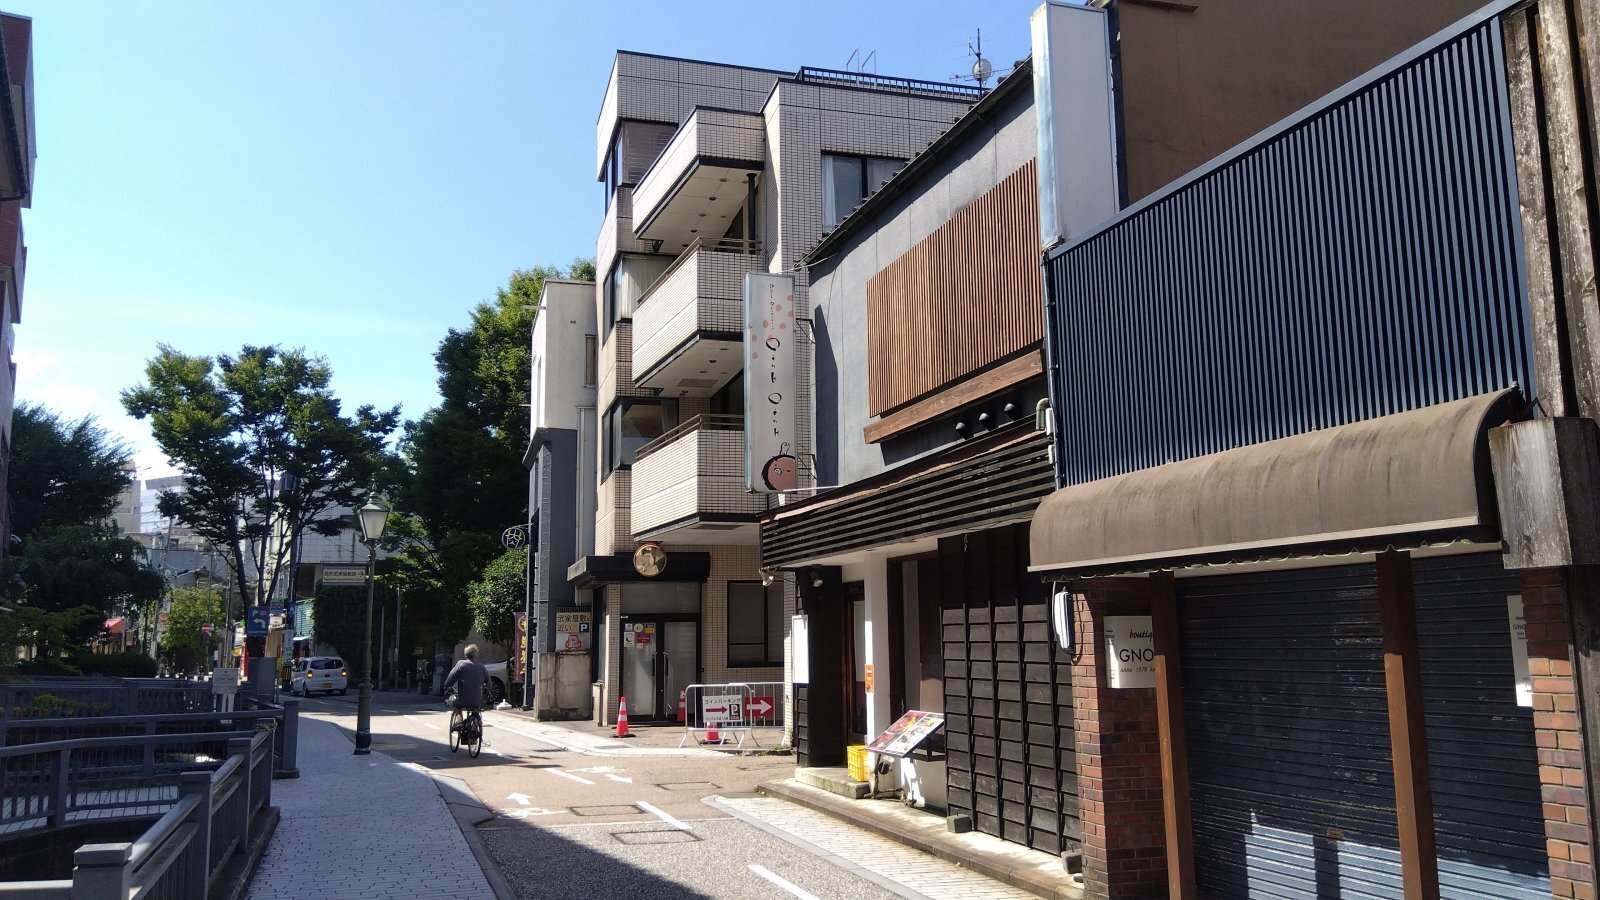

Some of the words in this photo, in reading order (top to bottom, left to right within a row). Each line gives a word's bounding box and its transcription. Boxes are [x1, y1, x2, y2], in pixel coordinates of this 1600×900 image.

[557, 624, 572, 632] 近い
[580, 623, 588, 632] P
[1119, 648, 1154, 662] GNO
